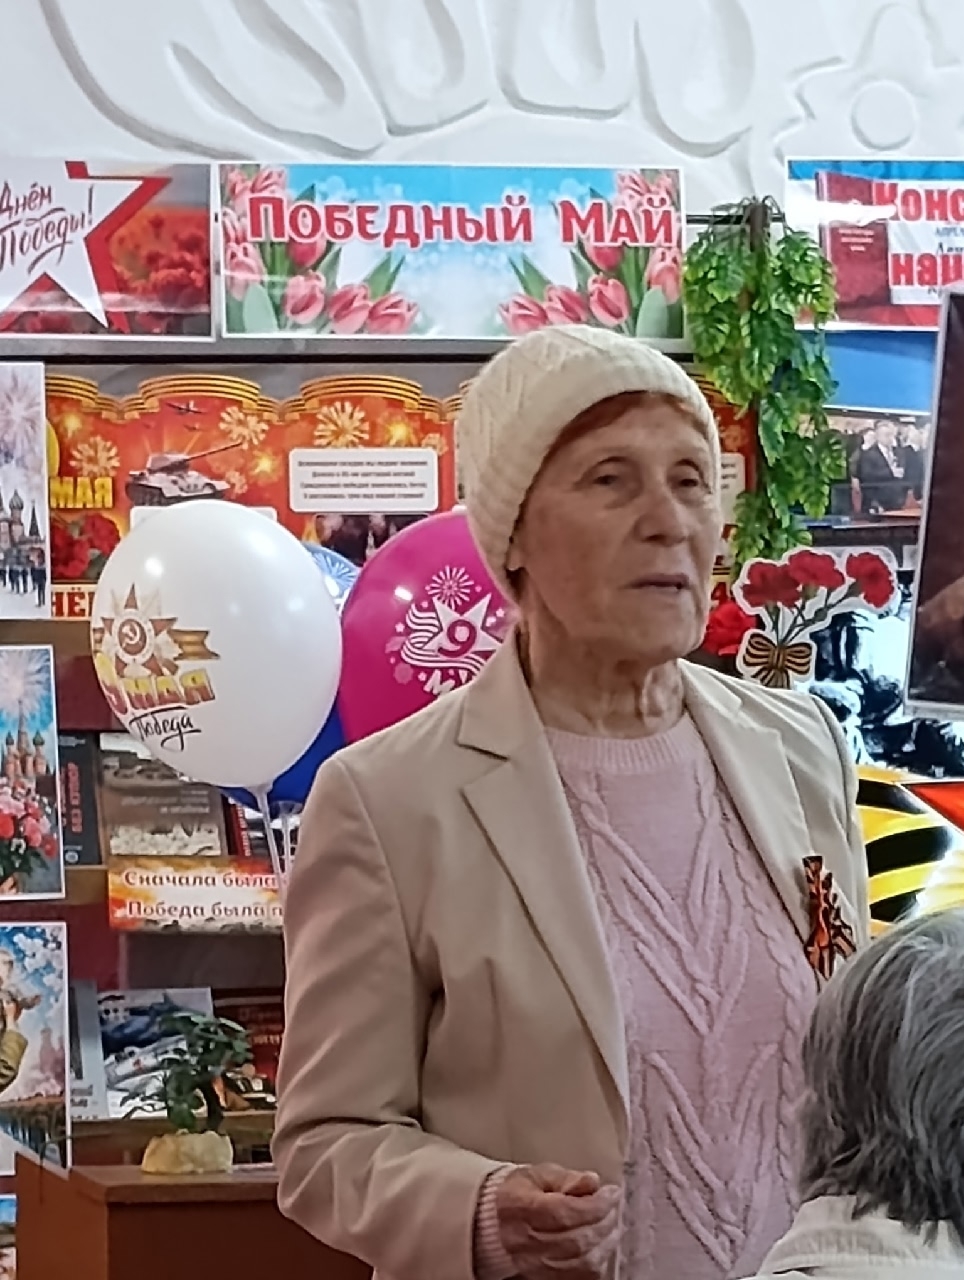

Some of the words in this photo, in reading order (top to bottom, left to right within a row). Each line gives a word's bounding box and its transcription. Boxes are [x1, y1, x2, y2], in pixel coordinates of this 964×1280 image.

[50, 476, 113, 508] МАЯ
[437, 619, 478, 658] 9
[129, 706, 202, 751] Победа
[124, 871, 217, 888] Сначала
[127, 901, 205, 919] Победа
